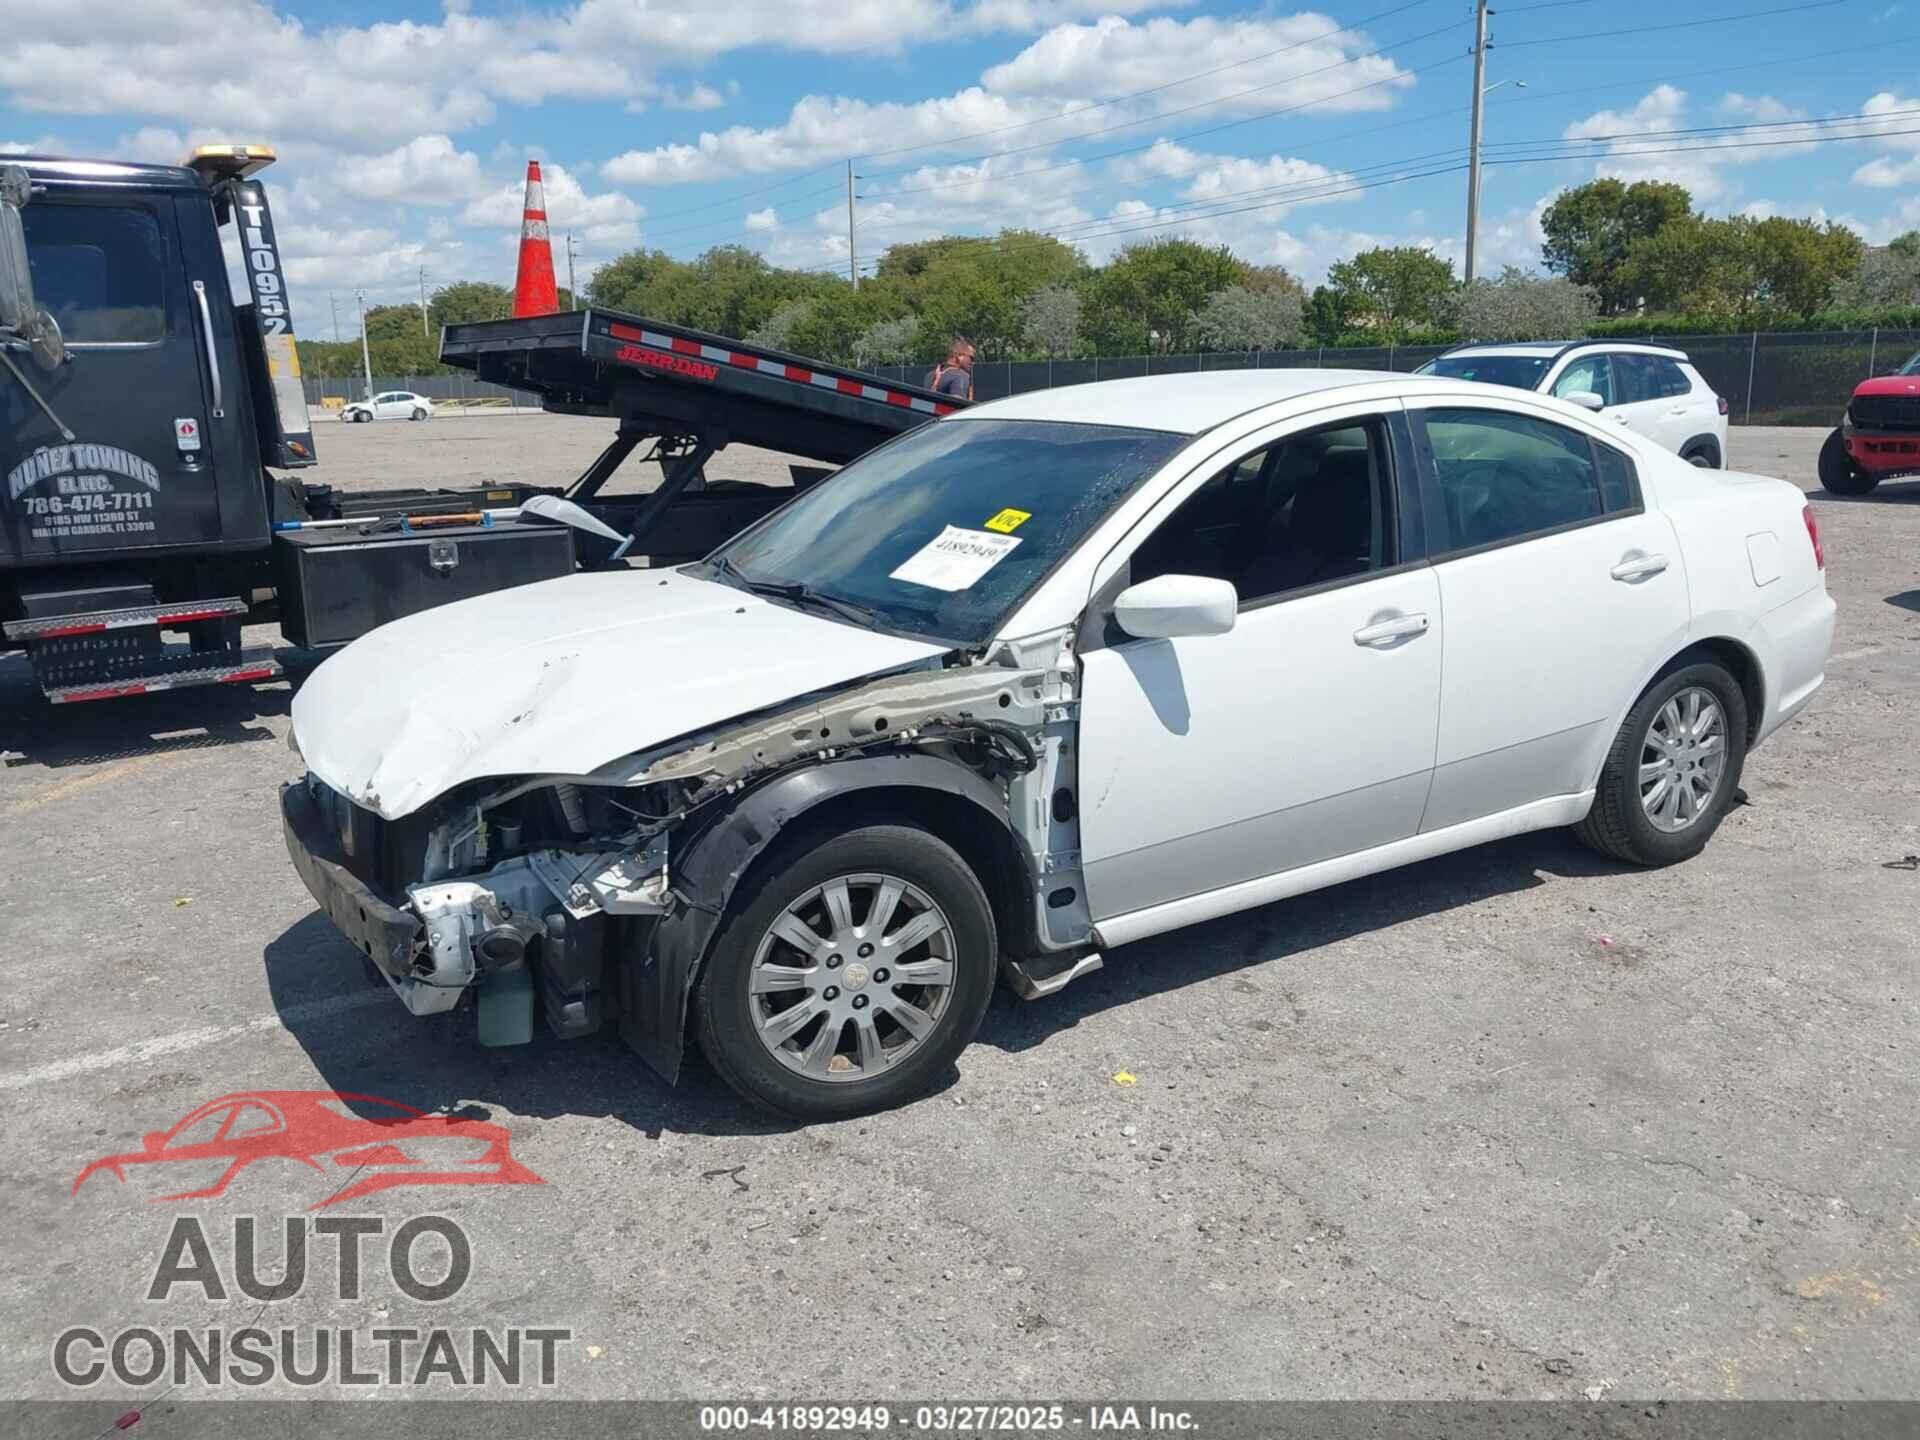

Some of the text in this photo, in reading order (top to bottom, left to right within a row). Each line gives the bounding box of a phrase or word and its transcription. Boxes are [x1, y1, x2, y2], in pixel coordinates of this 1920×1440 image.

[242, 206, 287, 335] TL0952
[73, 444, 160, 492] TOWING
[24, 492, 152, 515] 786-474-7711
[73, 513, 92, 524] NW
[126, 511, 139, 521] ST
